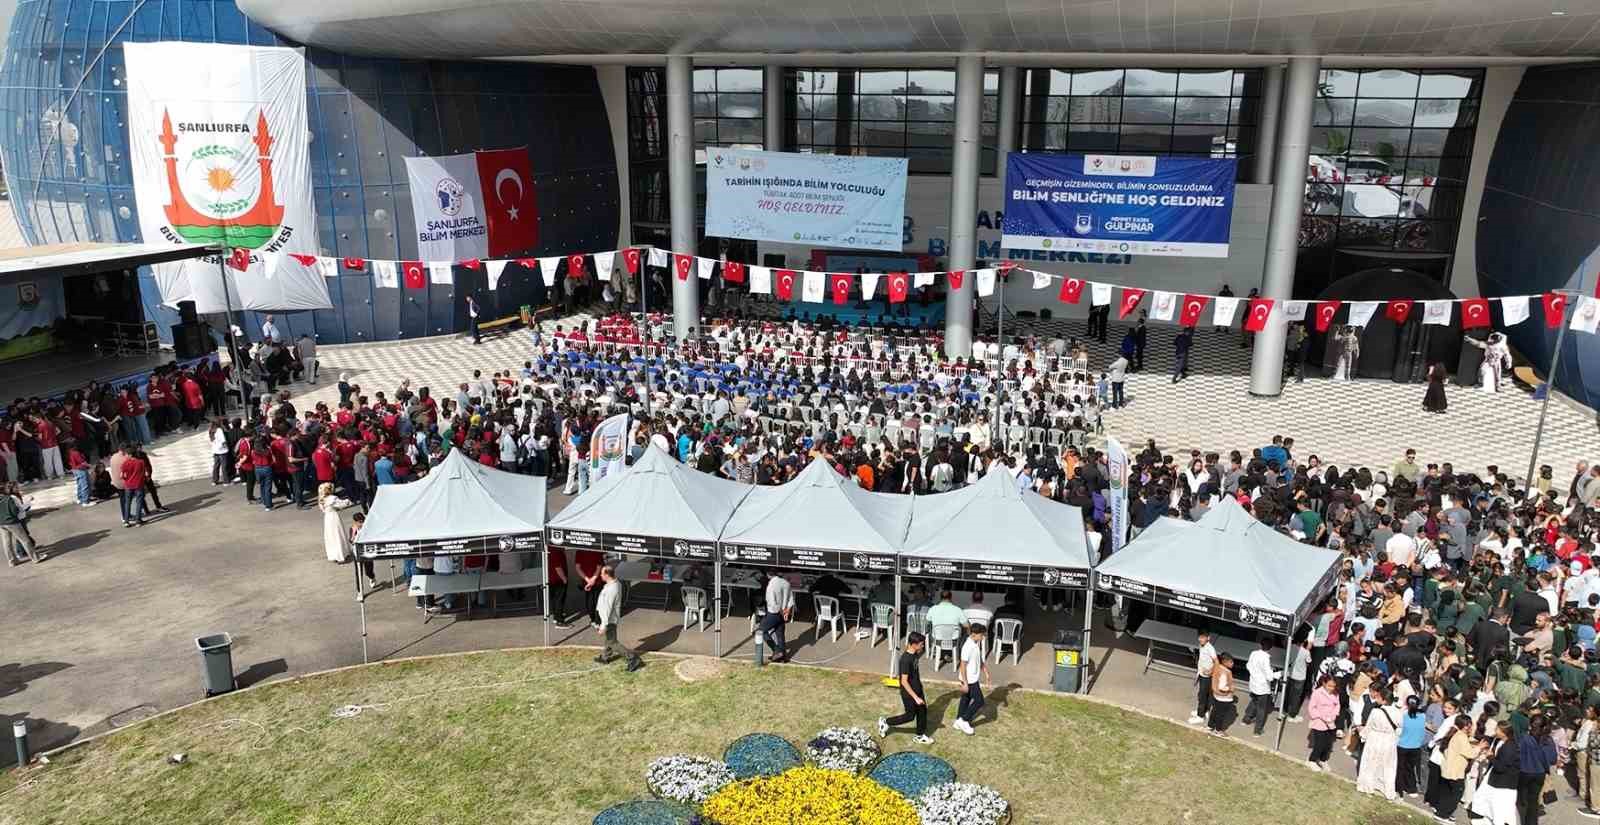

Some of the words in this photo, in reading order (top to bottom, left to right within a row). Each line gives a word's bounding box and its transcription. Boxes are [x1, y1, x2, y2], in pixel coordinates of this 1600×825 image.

[725, 176, 761, 187] TARİHİN
[762, 176, 802, 189] IŞIĞINDA
[804, 177, 829, 190] BİLİM
[830, 181, 886, 197] YOLCULUĞU
[1128, 193, 1157, 207] HOŞ
